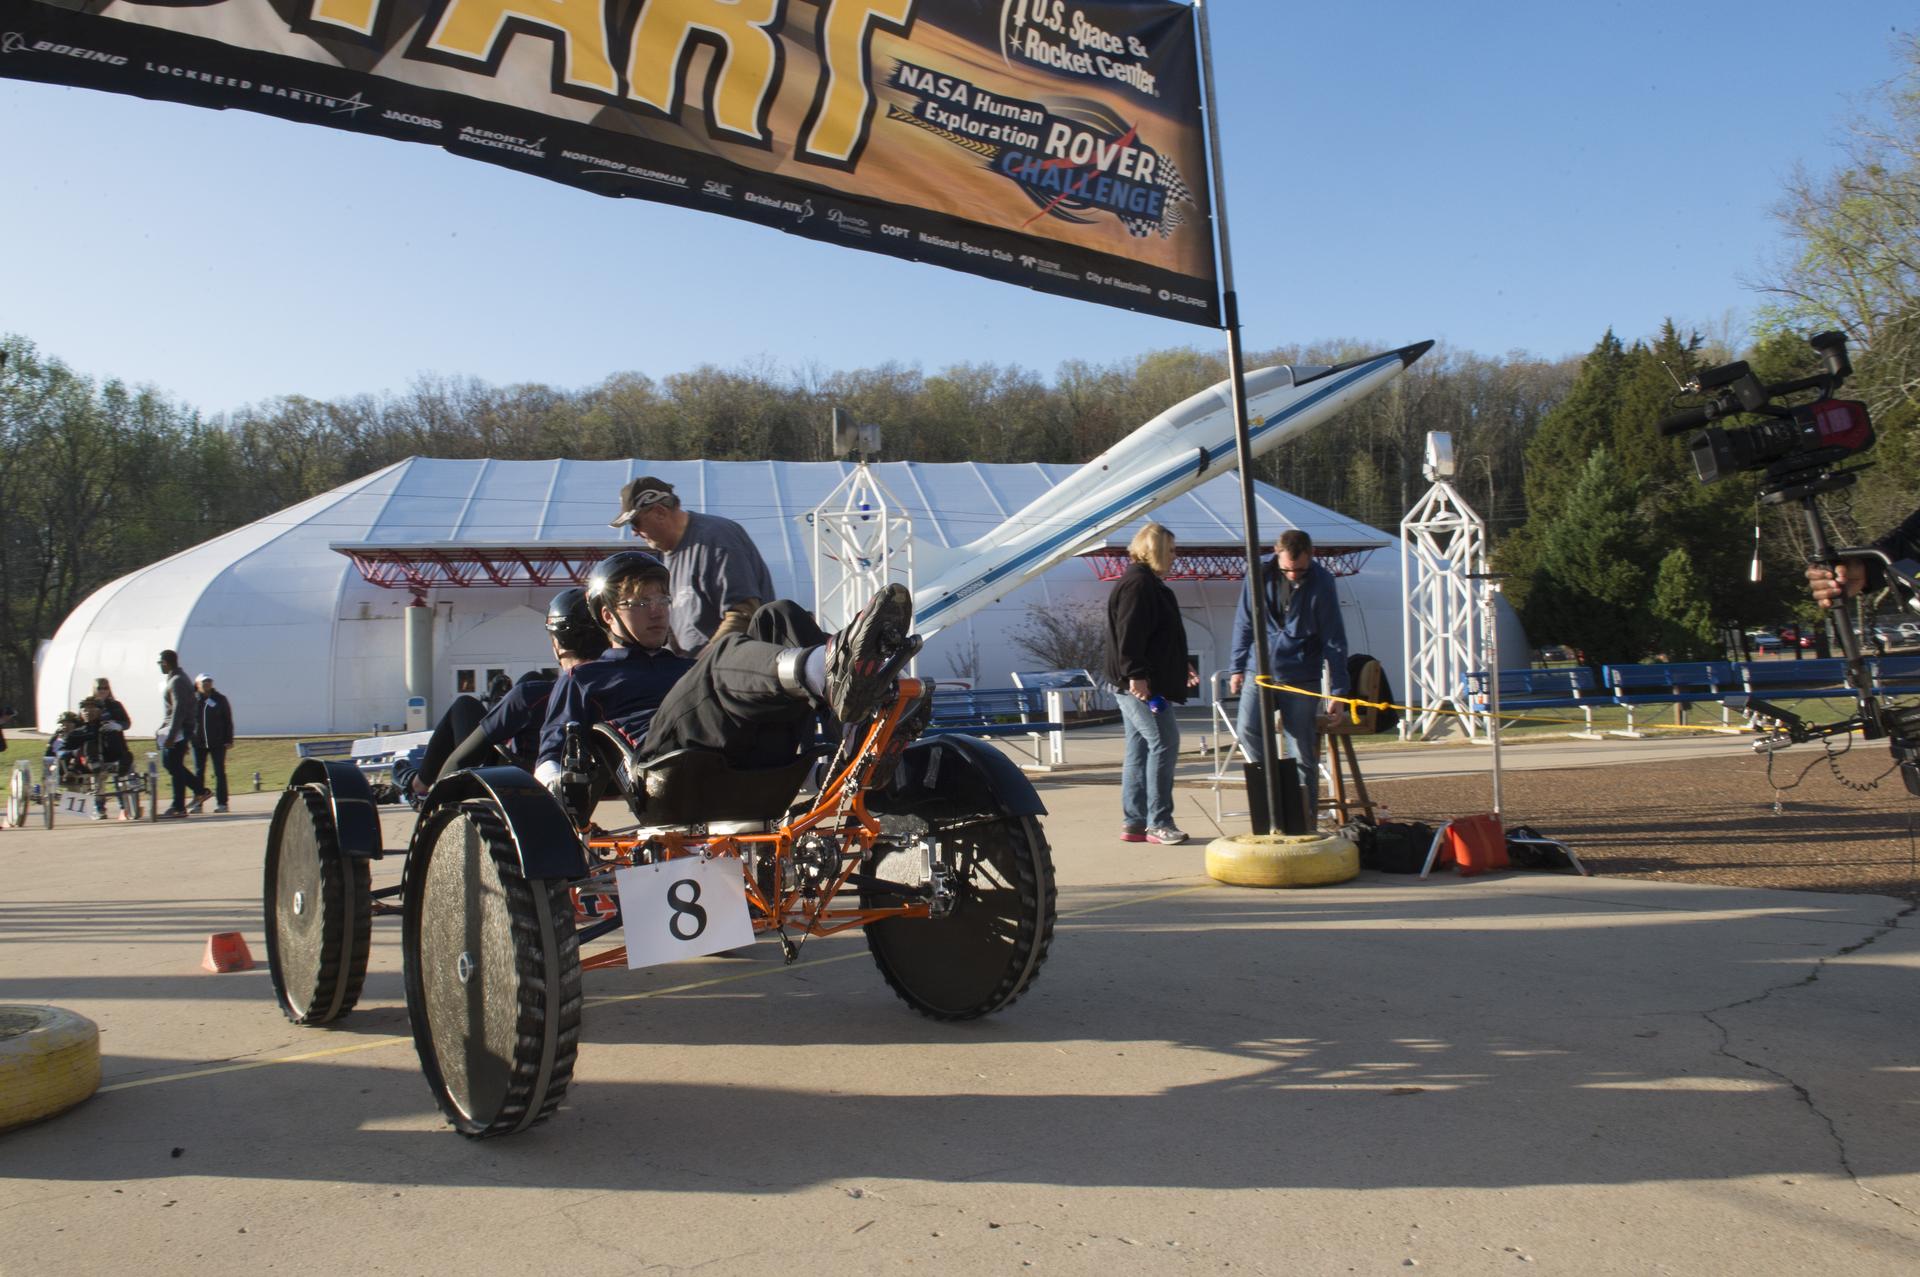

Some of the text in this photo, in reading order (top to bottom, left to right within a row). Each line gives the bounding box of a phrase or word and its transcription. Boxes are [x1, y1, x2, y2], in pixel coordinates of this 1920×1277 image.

[1024, 28, 1097, 75] Rocket
[1069, 10, 1125, 54] Space
[1127, 36, 1149, 58] &
[33, 41, 336, 108] BOEING LOCKHEED MARTIN
[899, 65, 1043, 125] NASA Human
[381, 110, 443, 130] JACOBS
[924, 101, 1156, 184] Exploration ROVER
[561, 150, 688, 185] NORTHROP GRUMMAN
[1002, 151, 1162, 216] CHALLENGE
[744, 191, 782, 209] Orbital
[880, 223, 911, 239] COPT
[919, 231, 1014, 262] National Space Club
[1085, 271, 1103, 285] City
[1103, 276, 1113, 286] of
[1171, 292, 1208, 308] POLARIS
[667, 879, 707, 941] 8
